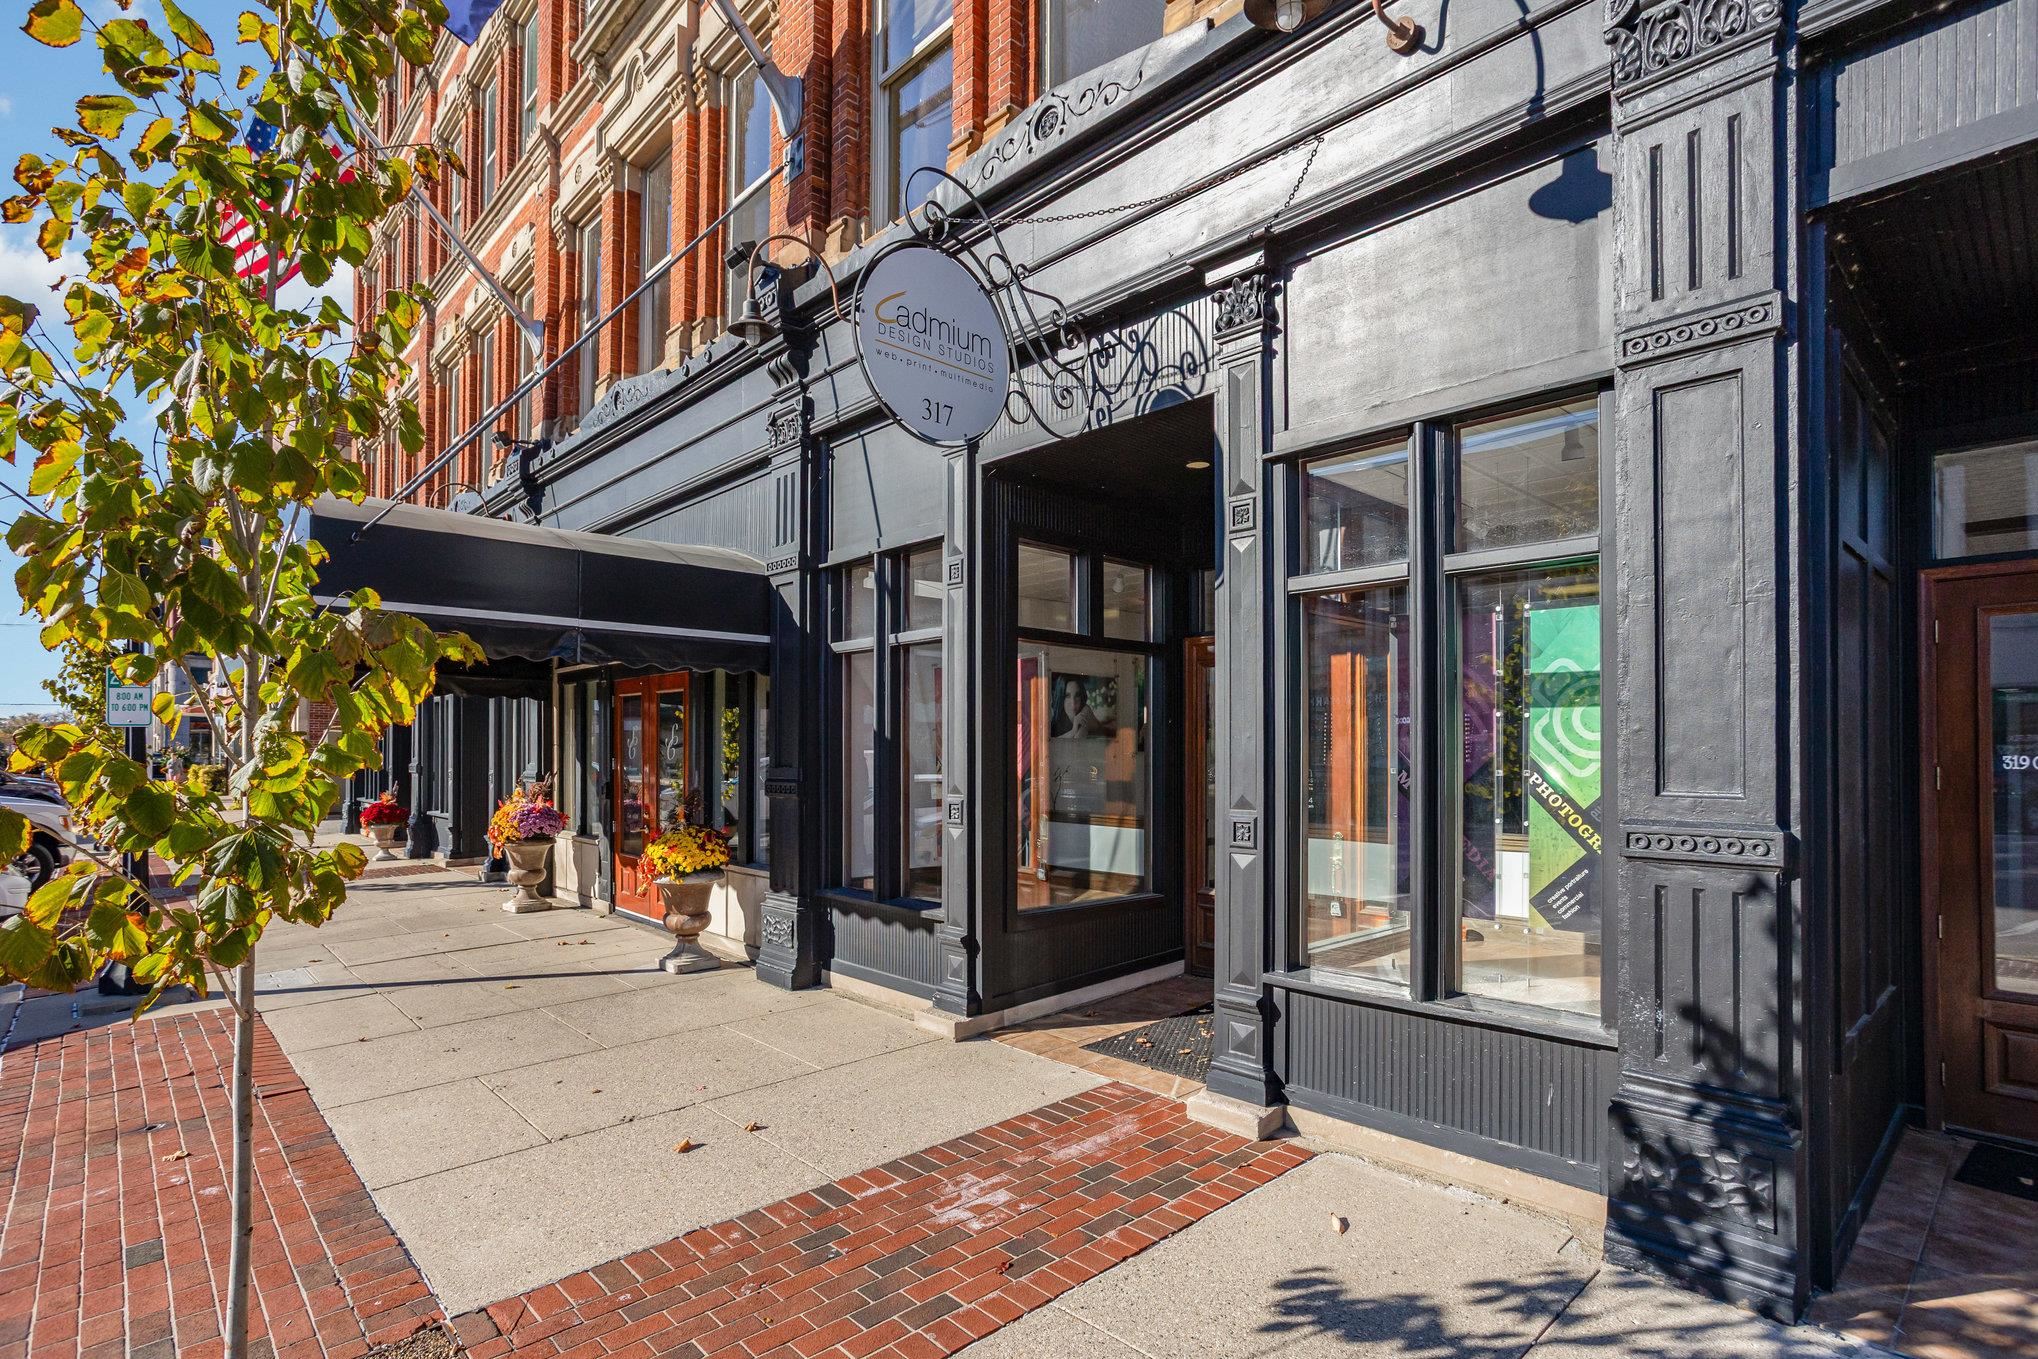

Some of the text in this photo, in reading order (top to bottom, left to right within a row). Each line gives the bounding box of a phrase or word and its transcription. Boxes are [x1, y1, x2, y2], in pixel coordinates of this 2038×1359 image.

[875, 290, 992, 359] Cadmium
[878, 322, 994, 374] DESIGN STUDIOS
[921, 398, 954, 427] 317
[111, 703, 149, 712] TO 6:00 PM
[116, 692, 144, 701] 8:00 AM
[2002, 755, 2031, 770] 319
